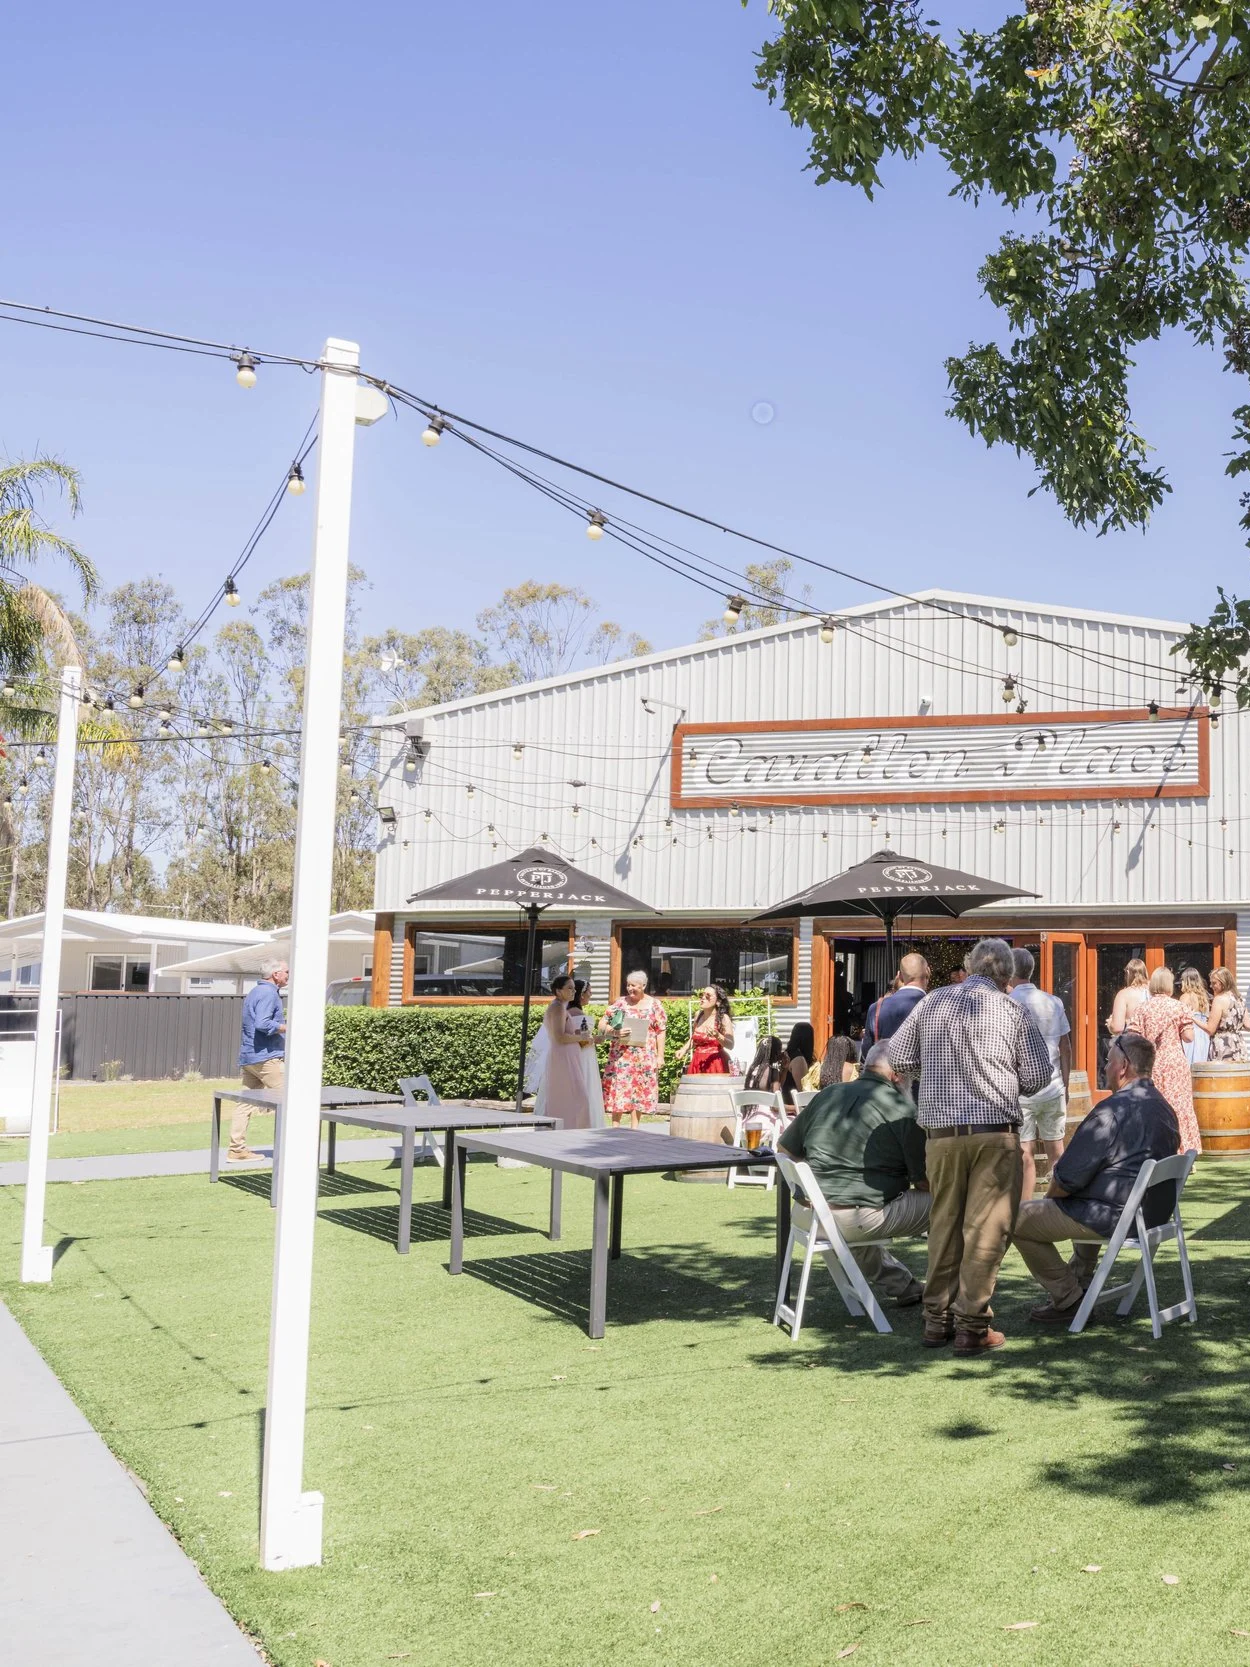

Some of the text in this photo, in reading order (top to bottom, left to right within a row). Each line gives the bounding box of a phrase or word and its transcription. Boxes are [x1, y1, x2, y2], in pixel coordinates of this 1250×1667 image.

[993, 727, 1188, 778] Place
[477, 888, 606, 902] PEPPERJACK
[857, 883, 981, 894] PEPPERJACK
